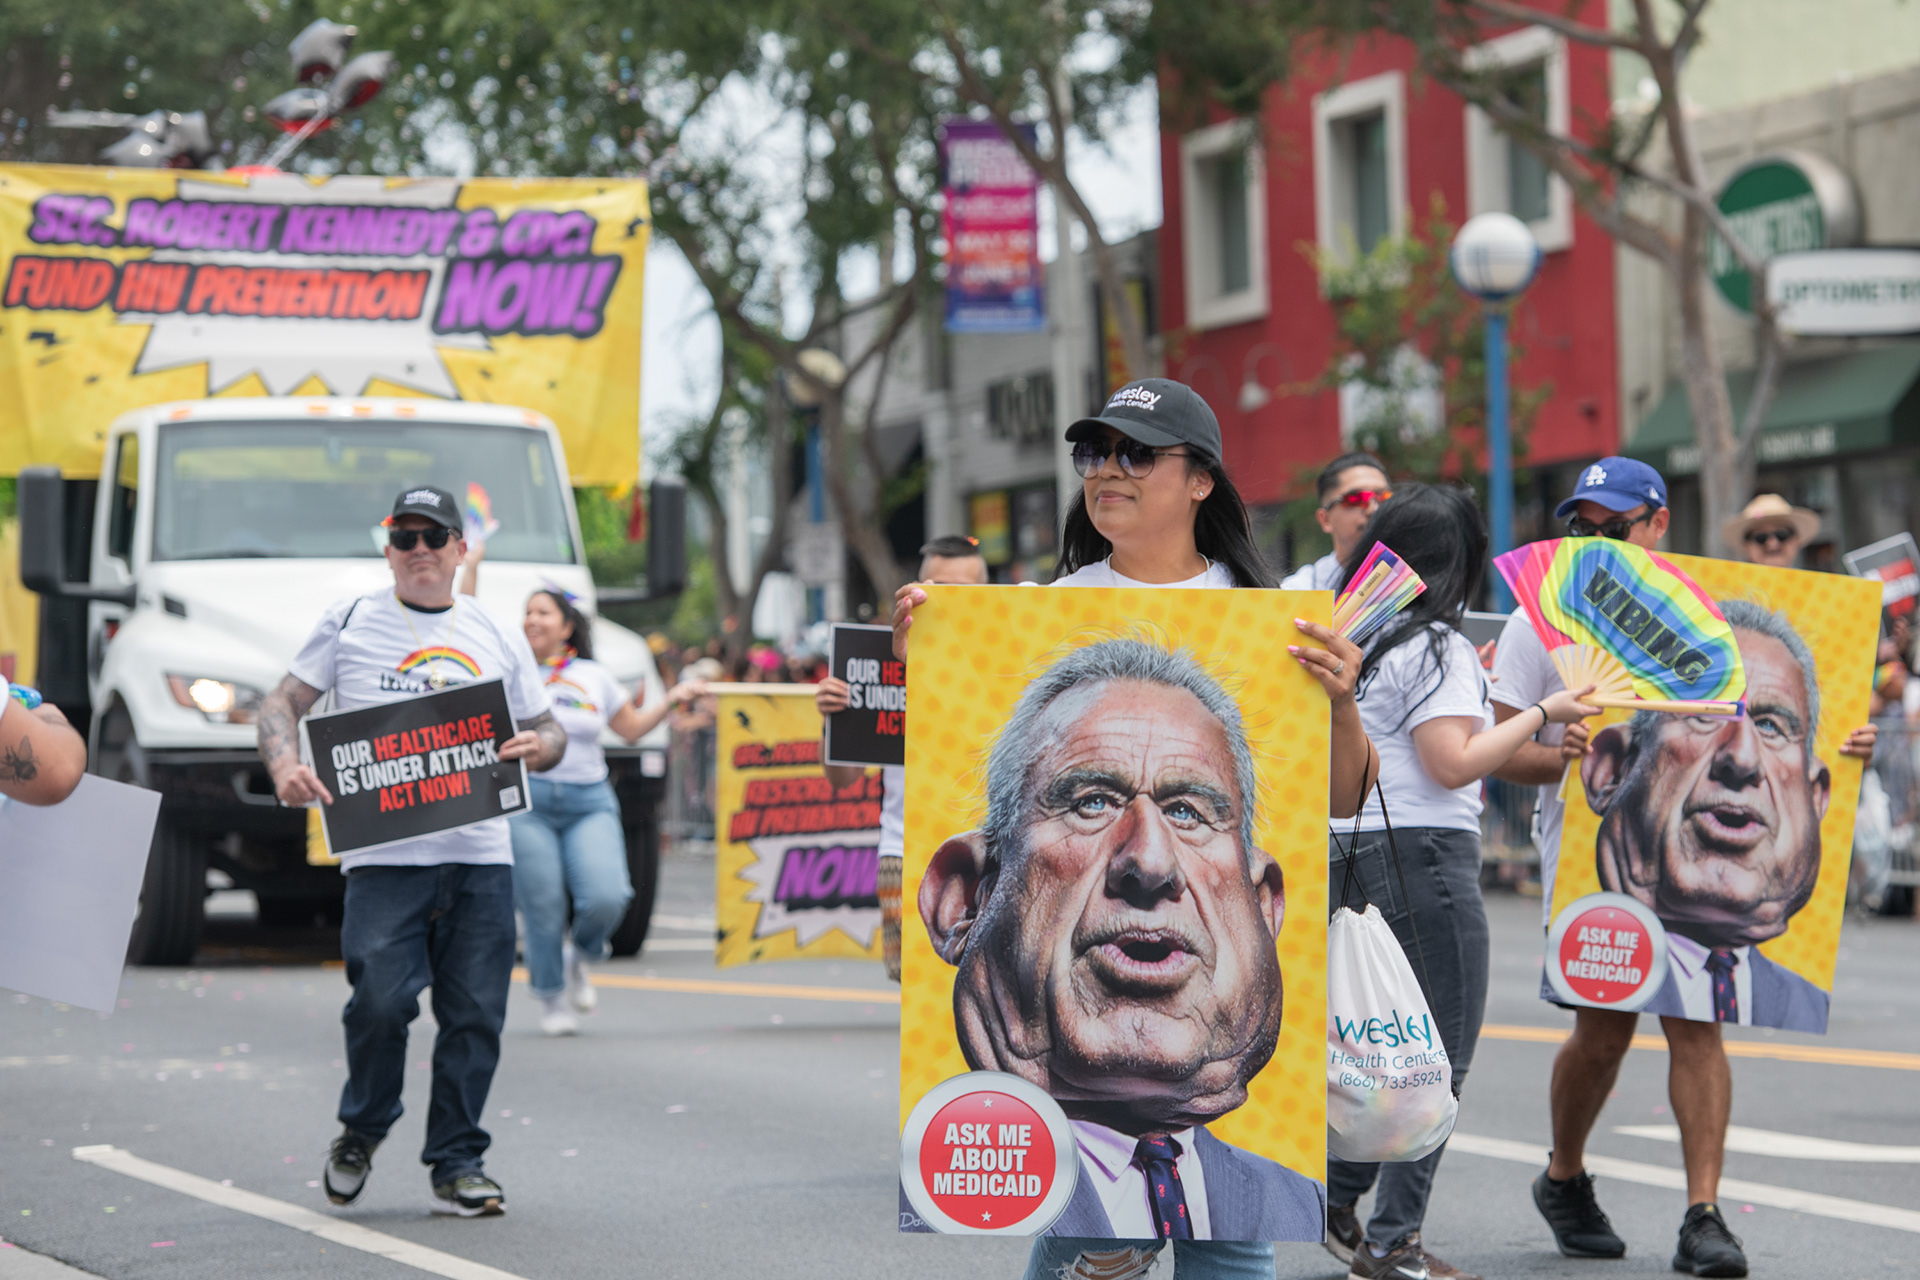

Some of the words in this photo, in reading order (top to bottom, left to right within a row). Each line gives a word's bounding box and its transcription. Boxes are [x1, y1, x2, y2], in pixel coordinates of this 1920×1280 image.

[31, 194, 116, 245] SEC.
[123, 200, 283, 252] ROBERT
[279, 206, 459, 257] KENNEDY
[458, 209, 499, 258] &
[5, 257, 115, 310] FUND
[114, 261, 190, 313] HIV
[186, 264, 429, 320] PREVENTION
[438, 259, 615, 332] NOW!
[1112, 386, 1162, 405] wesley
[1126, 399, 1155, 411] Centers
[1582, 563, 1714, 685] VIBING
[846, 657, 880, 684] OUR
[882, 660, 906, 686] HE
[846, 682, 864, 709] IS
[865, 684, 906, 712] UNDE
[331, 739, 374, 771] OUR
[374, 713, 496, 762] HEALTHCARE
[336, 768, 360, 796] IS
[359, 754, 426, 791] UNDER
[429, 738, 500, 777] ATTACK
[379, 782, 415, 813] ACT
[418, 771, 472, 804] NOW!
[1577, 926, 1611, 946] ASK
[1615, 930, 1640, 949] ME
[1579, 944, 1634, 966] ABOUT
[1565, 959, 1642, 985] MEDICAID
[1334, 1009, 1432, 1050] wesley
[1331, 1050, 1387, 1068] Health
[1392, 1049, 1447, 1070] Centers
[1338, 1071, 1376, 1090] (866)
[1381, 1070, 1443, 1089] 733-5924
[943, 1122, 992, 1146] ASK
[998, 1124, 1032, 1147] ME
[949, 1148, 1027, 1172] ABOUT
[933, 1172, 1042, 1197] MEDICAID
